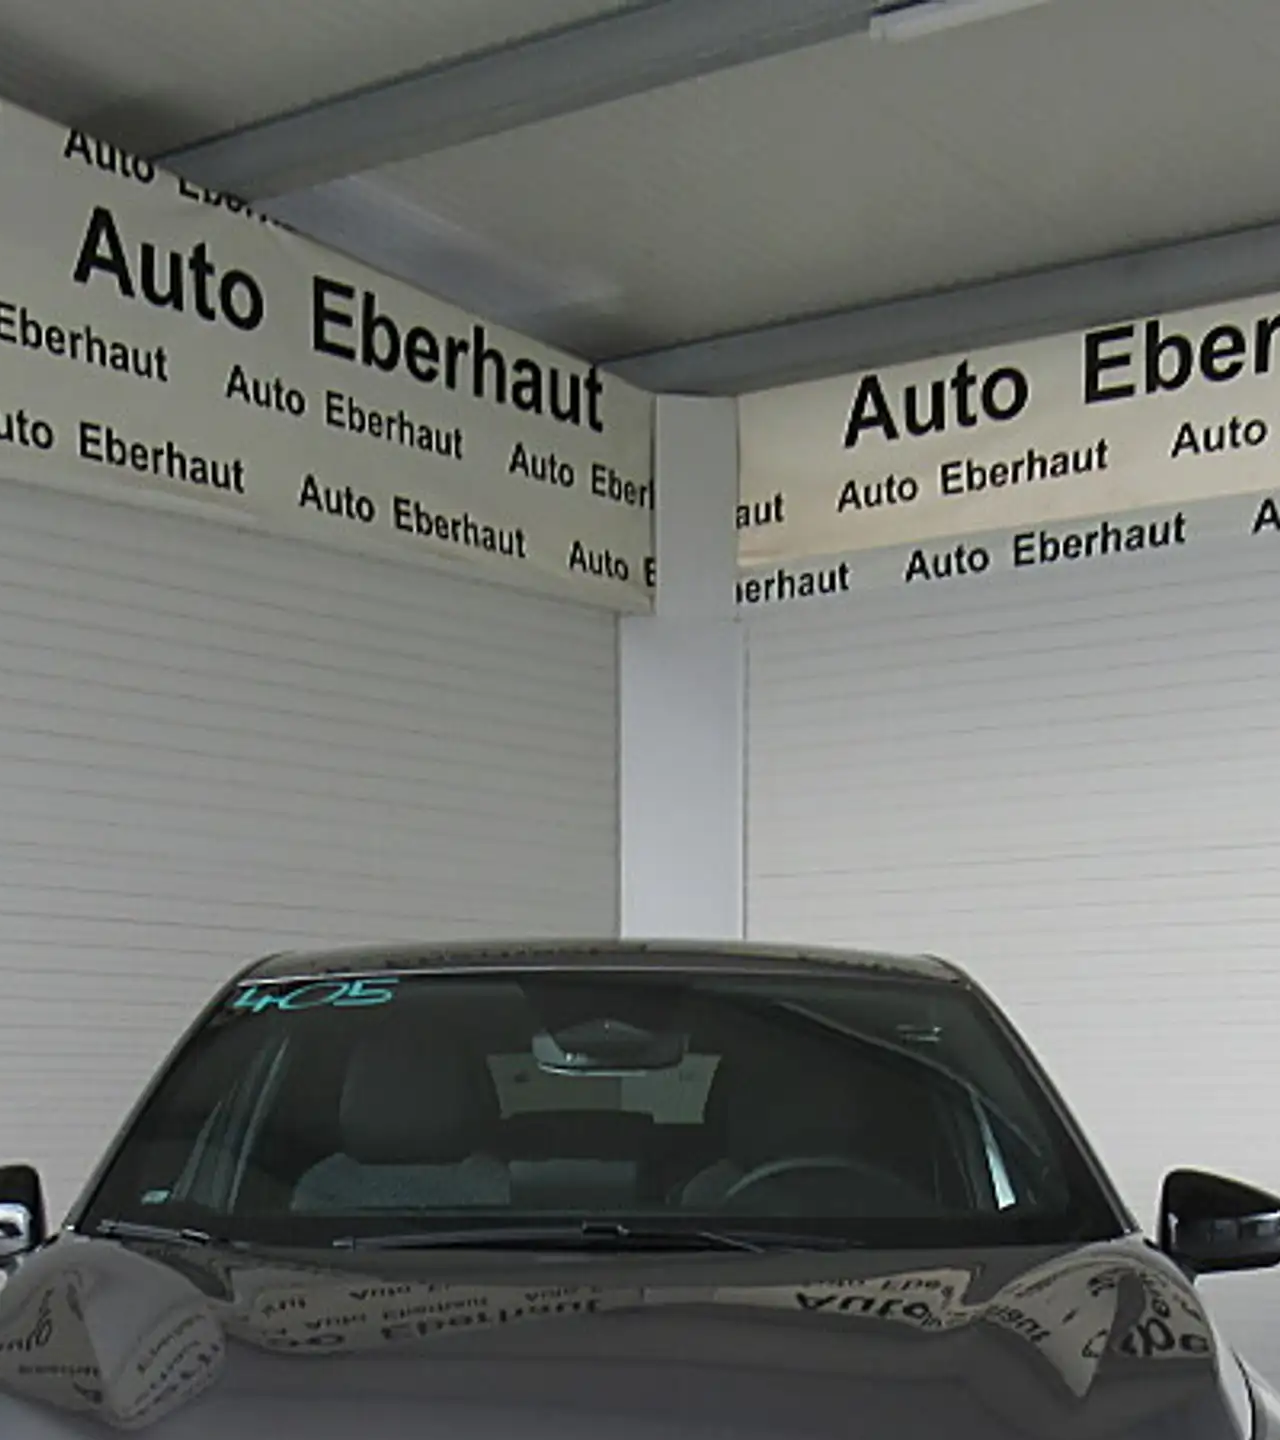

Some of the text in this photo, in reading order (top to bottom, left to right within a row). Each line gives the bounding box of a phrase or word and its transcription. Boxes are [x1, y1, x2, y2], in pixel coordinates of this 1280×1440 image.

[72, 206, 604, 433] Auto Eberhaut
[225, 364, 463, 460] Auto Eberhaut
[844, 367, 1028, 449] Auto
[1171, 414, 1268, 459] Auto
[79, 421, 245, 494] Eberhaut
[509, 442, 574, 488] Auto
[837, 438, 1110, 514] Auto Eberhaut
[299, 473, 526, 559] Auto Eberhaut
[905, 511, 1186, 584] Auto Eberhaut
[569, 540, 630, 584] Auto
[233, 976, 401, 1013] 405
